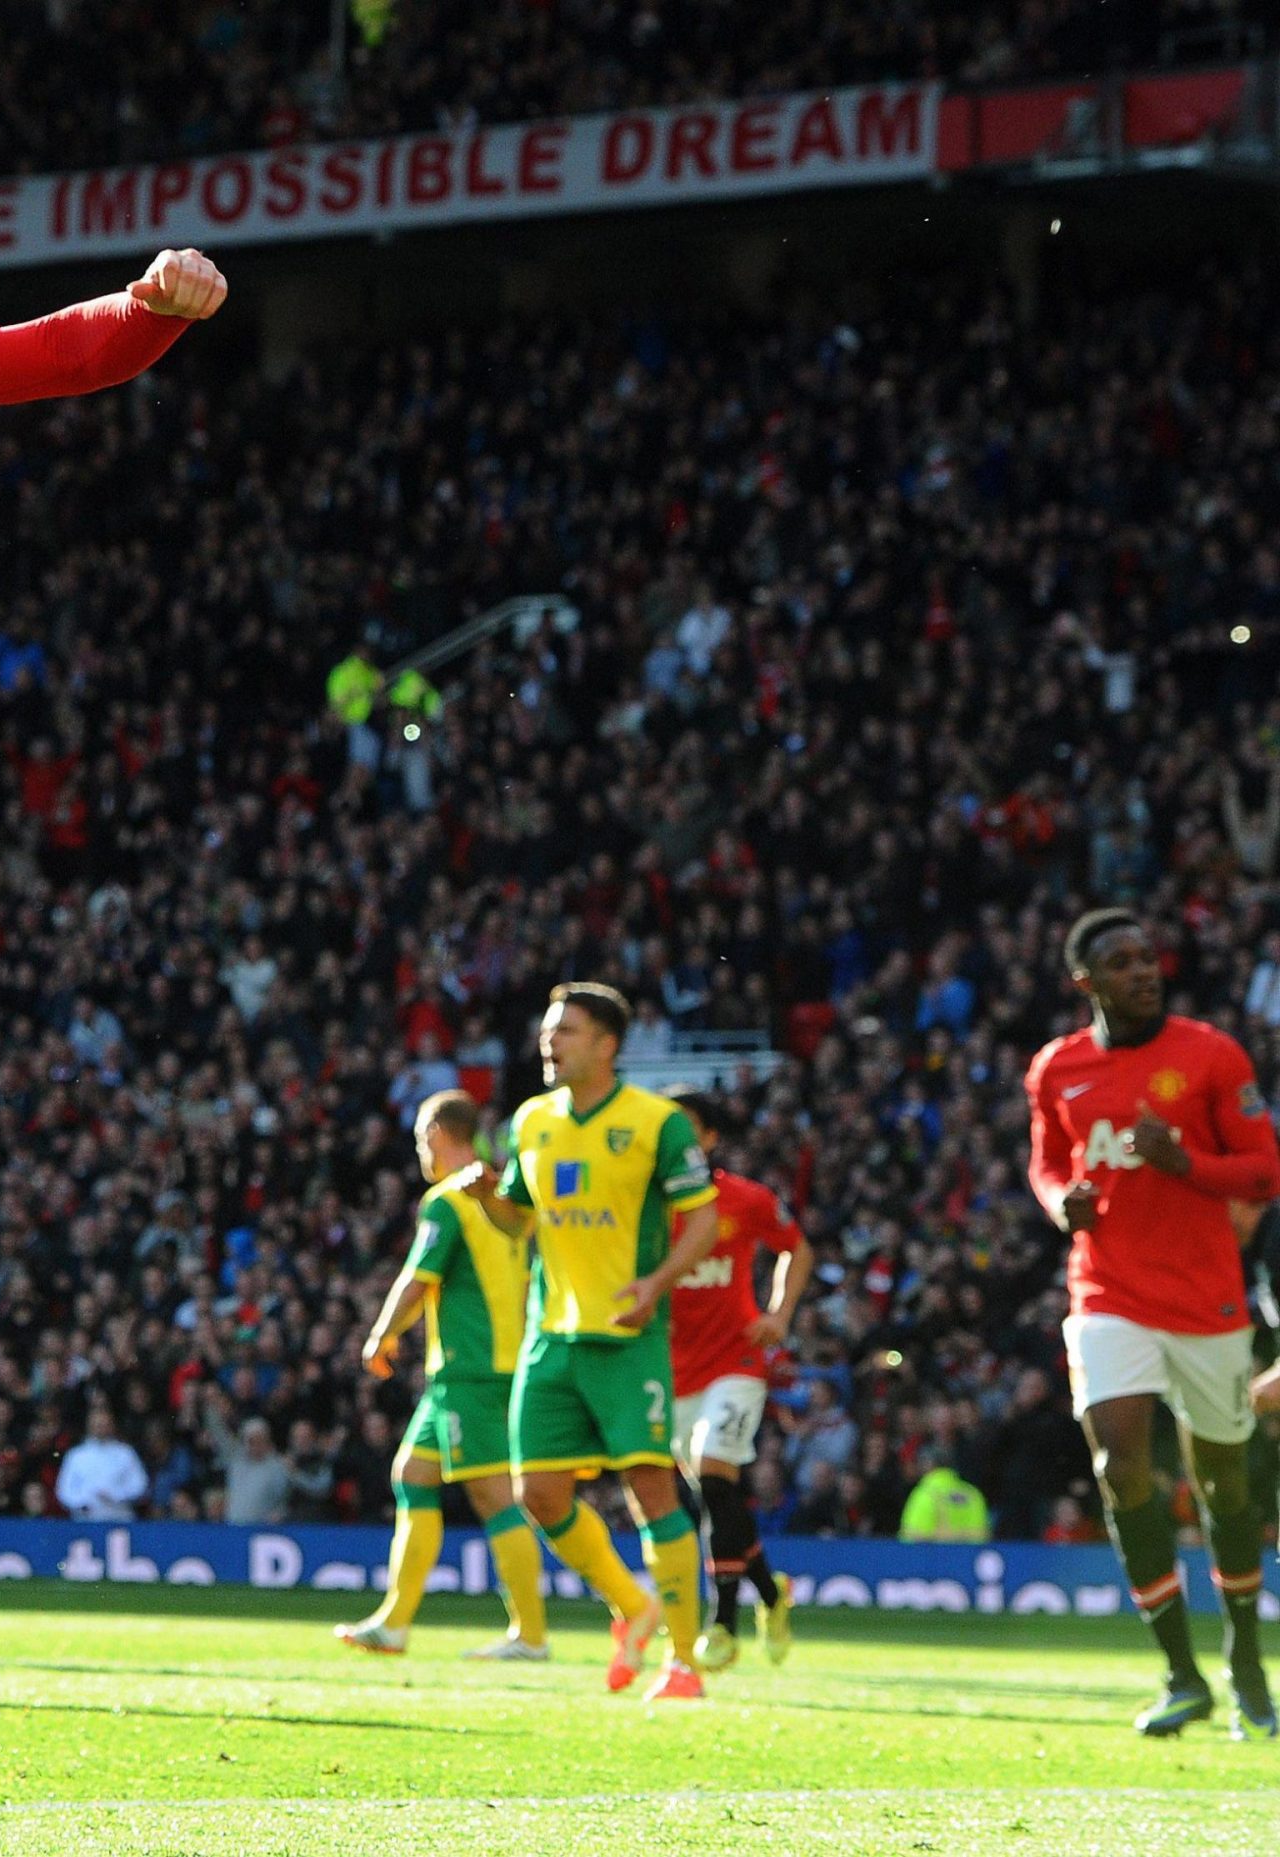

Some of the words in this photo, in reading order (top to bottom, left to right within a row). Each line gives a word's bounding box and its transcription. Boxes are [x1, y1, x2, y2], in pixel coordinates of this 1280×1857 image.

[50, 123, 570, 239] IMPOSSIBLE
[602, 91, 923, 184] DREAM
[541, 1206, 617, 1229] VIVA
[642, 1379, 666, 1424] 2
